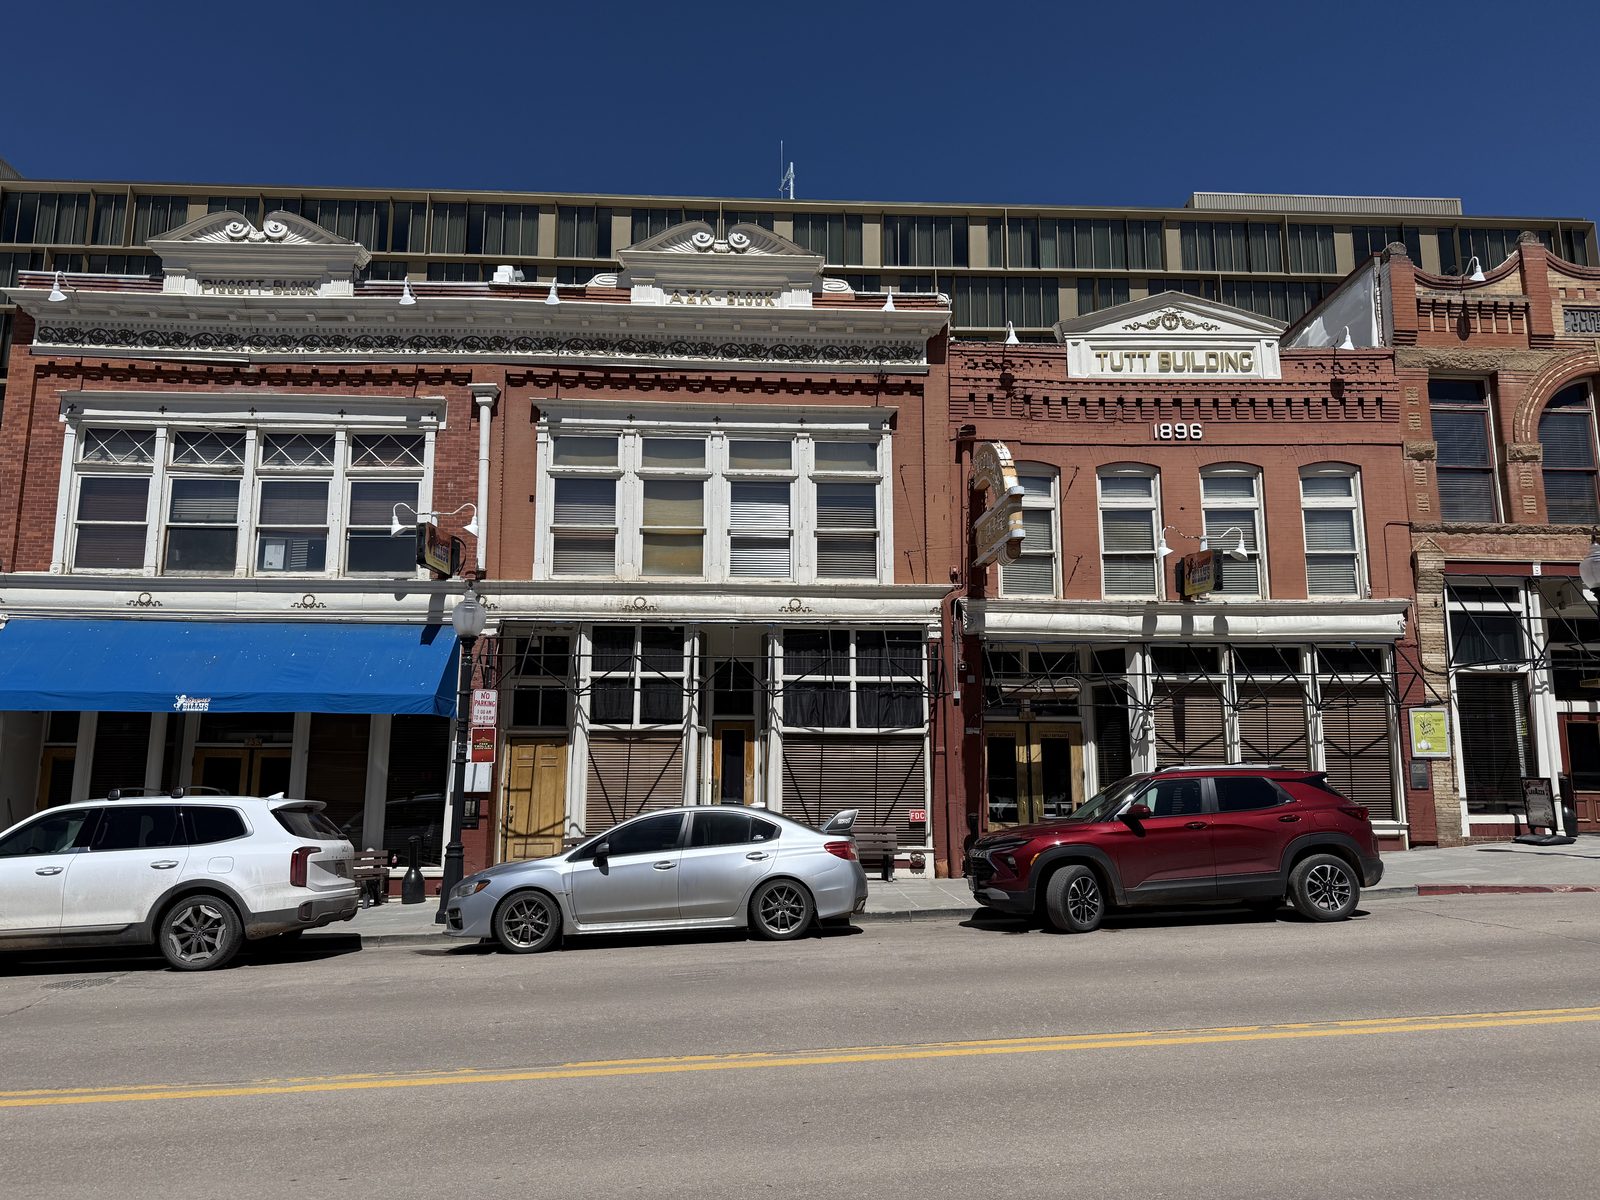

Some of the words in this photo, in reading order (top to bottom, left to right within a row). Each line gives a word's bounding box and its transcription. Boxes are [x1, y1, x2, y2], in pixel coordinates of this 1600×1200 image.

[1095, 351, 1150, 372] TUTT
[1158, 351, 1254, 373] BUILDING
[1153, 422, 1203, 440] 1896
[910, 812, 925, 820] FDC
